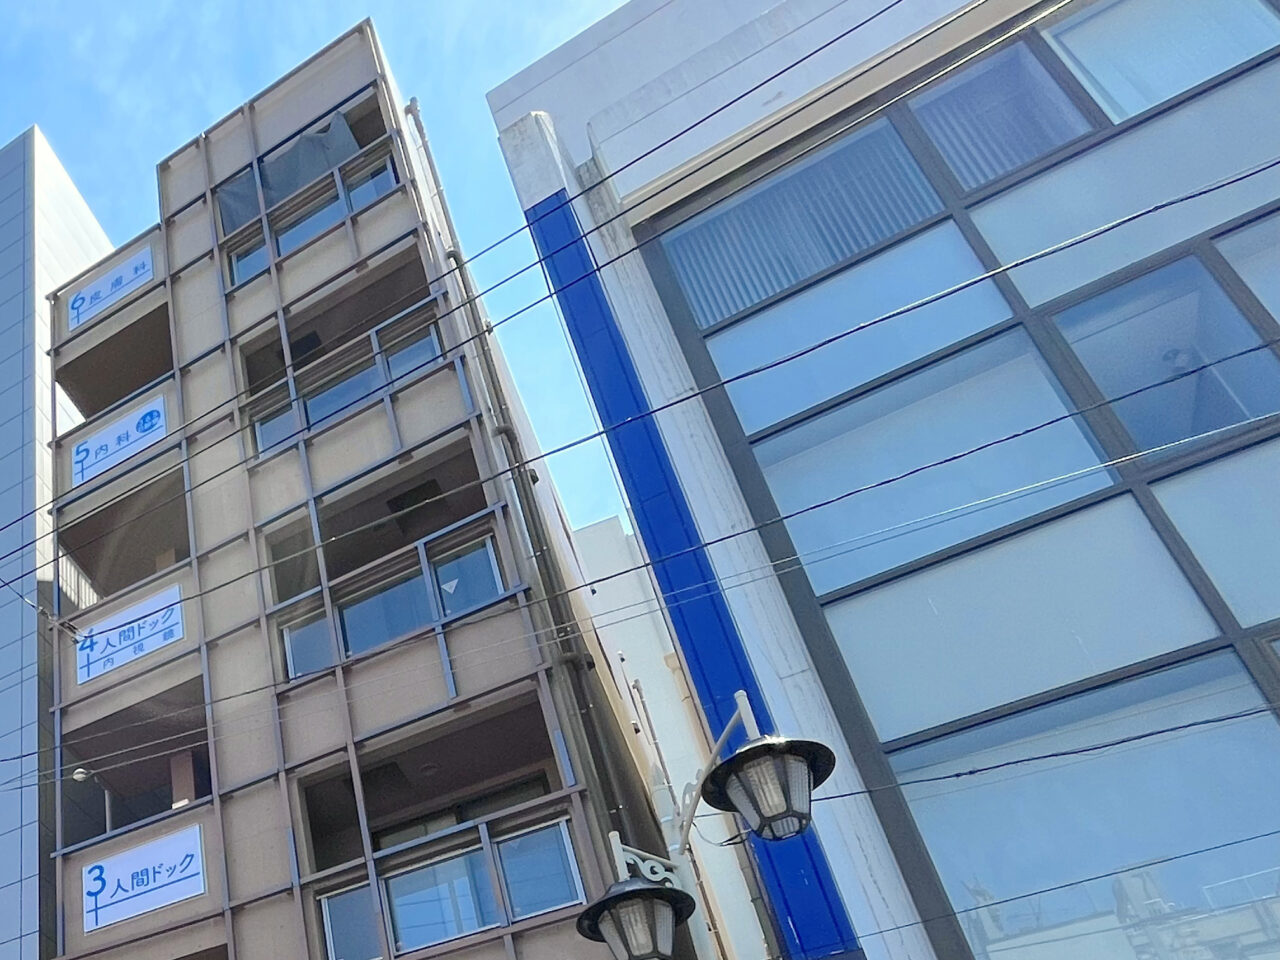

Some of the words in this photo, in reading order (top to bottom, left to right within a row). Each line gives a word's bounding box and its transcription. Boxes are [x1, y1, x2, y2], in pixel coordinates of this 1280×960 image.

[94, 430, 131, 459] 内科
[100, 607, 175, 654] 人間ドック
[87, 864, 106, 898] 3
[110, 853, 195, 899] 人間ドック
